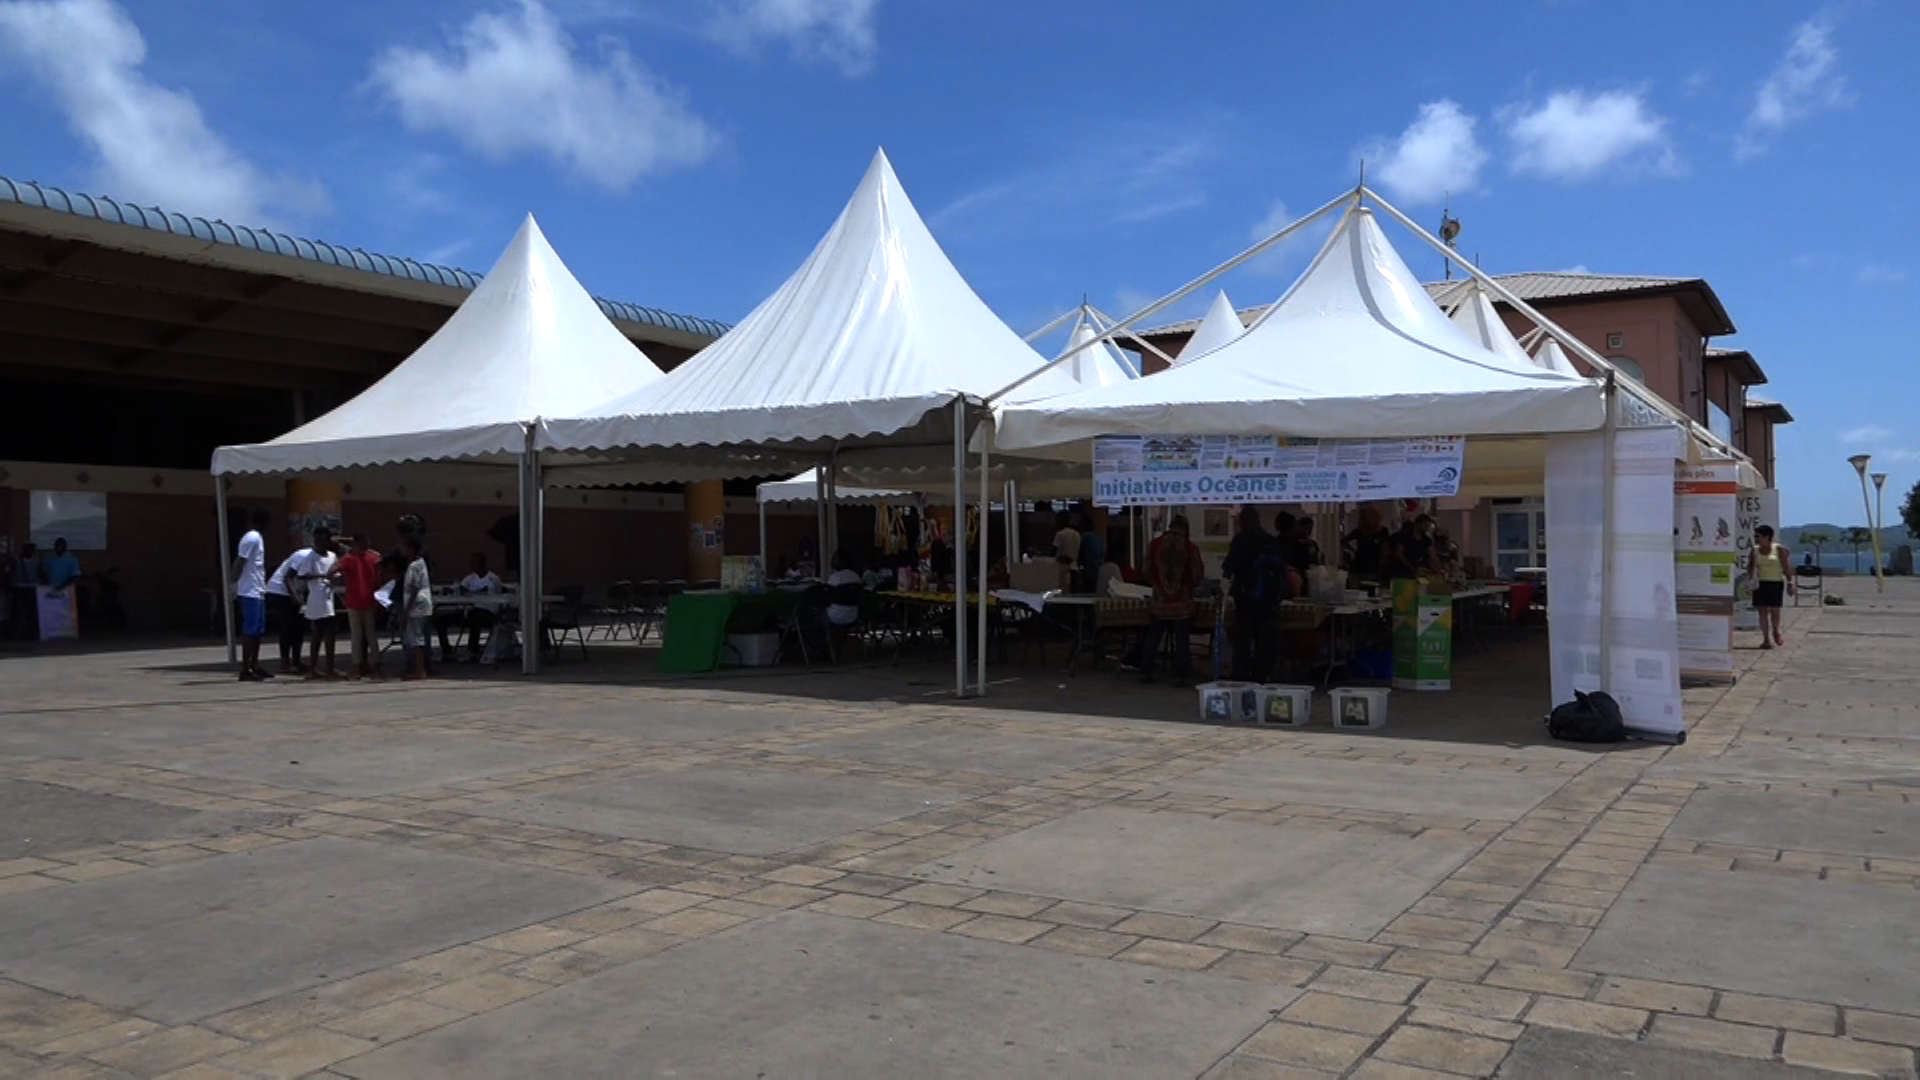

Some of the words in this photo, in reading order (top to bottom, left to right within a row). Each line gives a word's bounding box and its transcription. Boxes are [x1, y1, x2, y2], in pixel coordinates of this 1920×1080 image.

[1096, 477, 1192, 496] Initiatives
[1737, 497, 1761, 512] YES
[1739, 516, 1760, 531] WE
